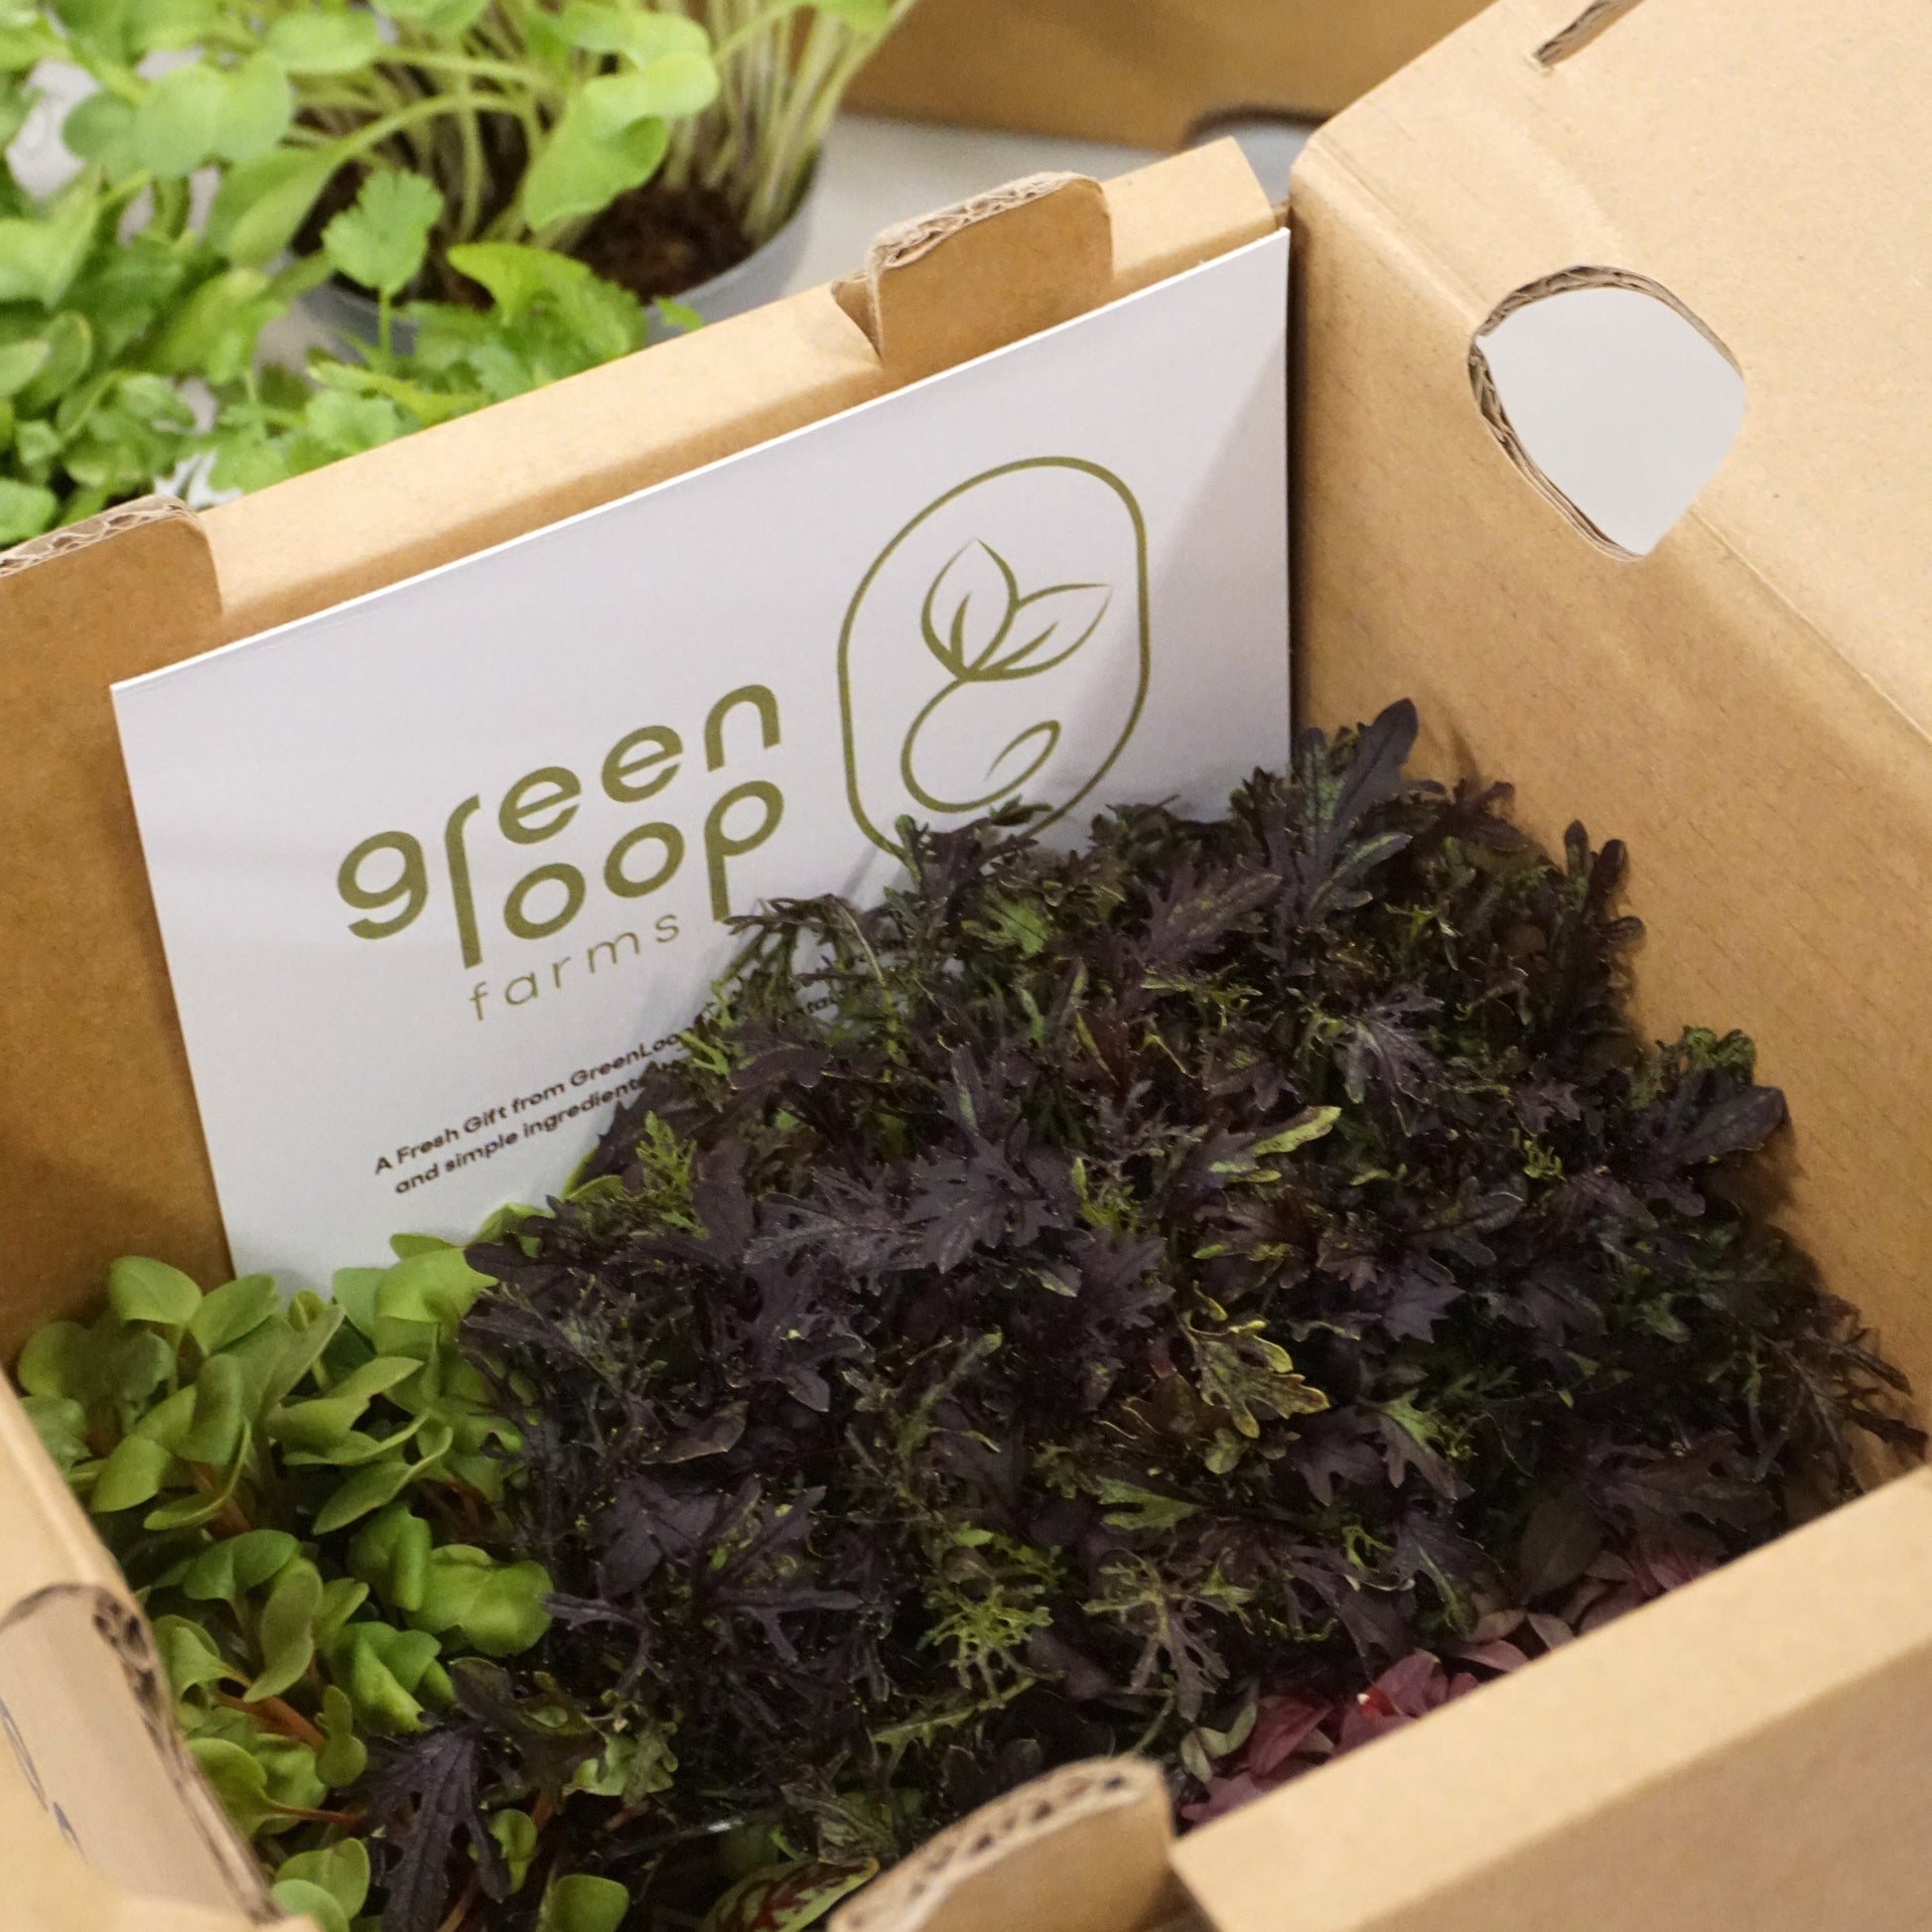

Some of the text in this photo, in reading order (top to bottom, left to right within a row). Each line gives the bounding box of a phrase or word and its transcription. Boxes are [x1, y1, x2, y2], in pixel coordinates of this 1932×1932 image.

[338, 683, 781, 943] green
[445, 779, 785, 970] loop
[470, 912, 681, 1021] farms
[374, 1033, 683, 1175] A Fresh Gift from GreenLoo
[394, 1077, 642, 1194] and simple ingredient
